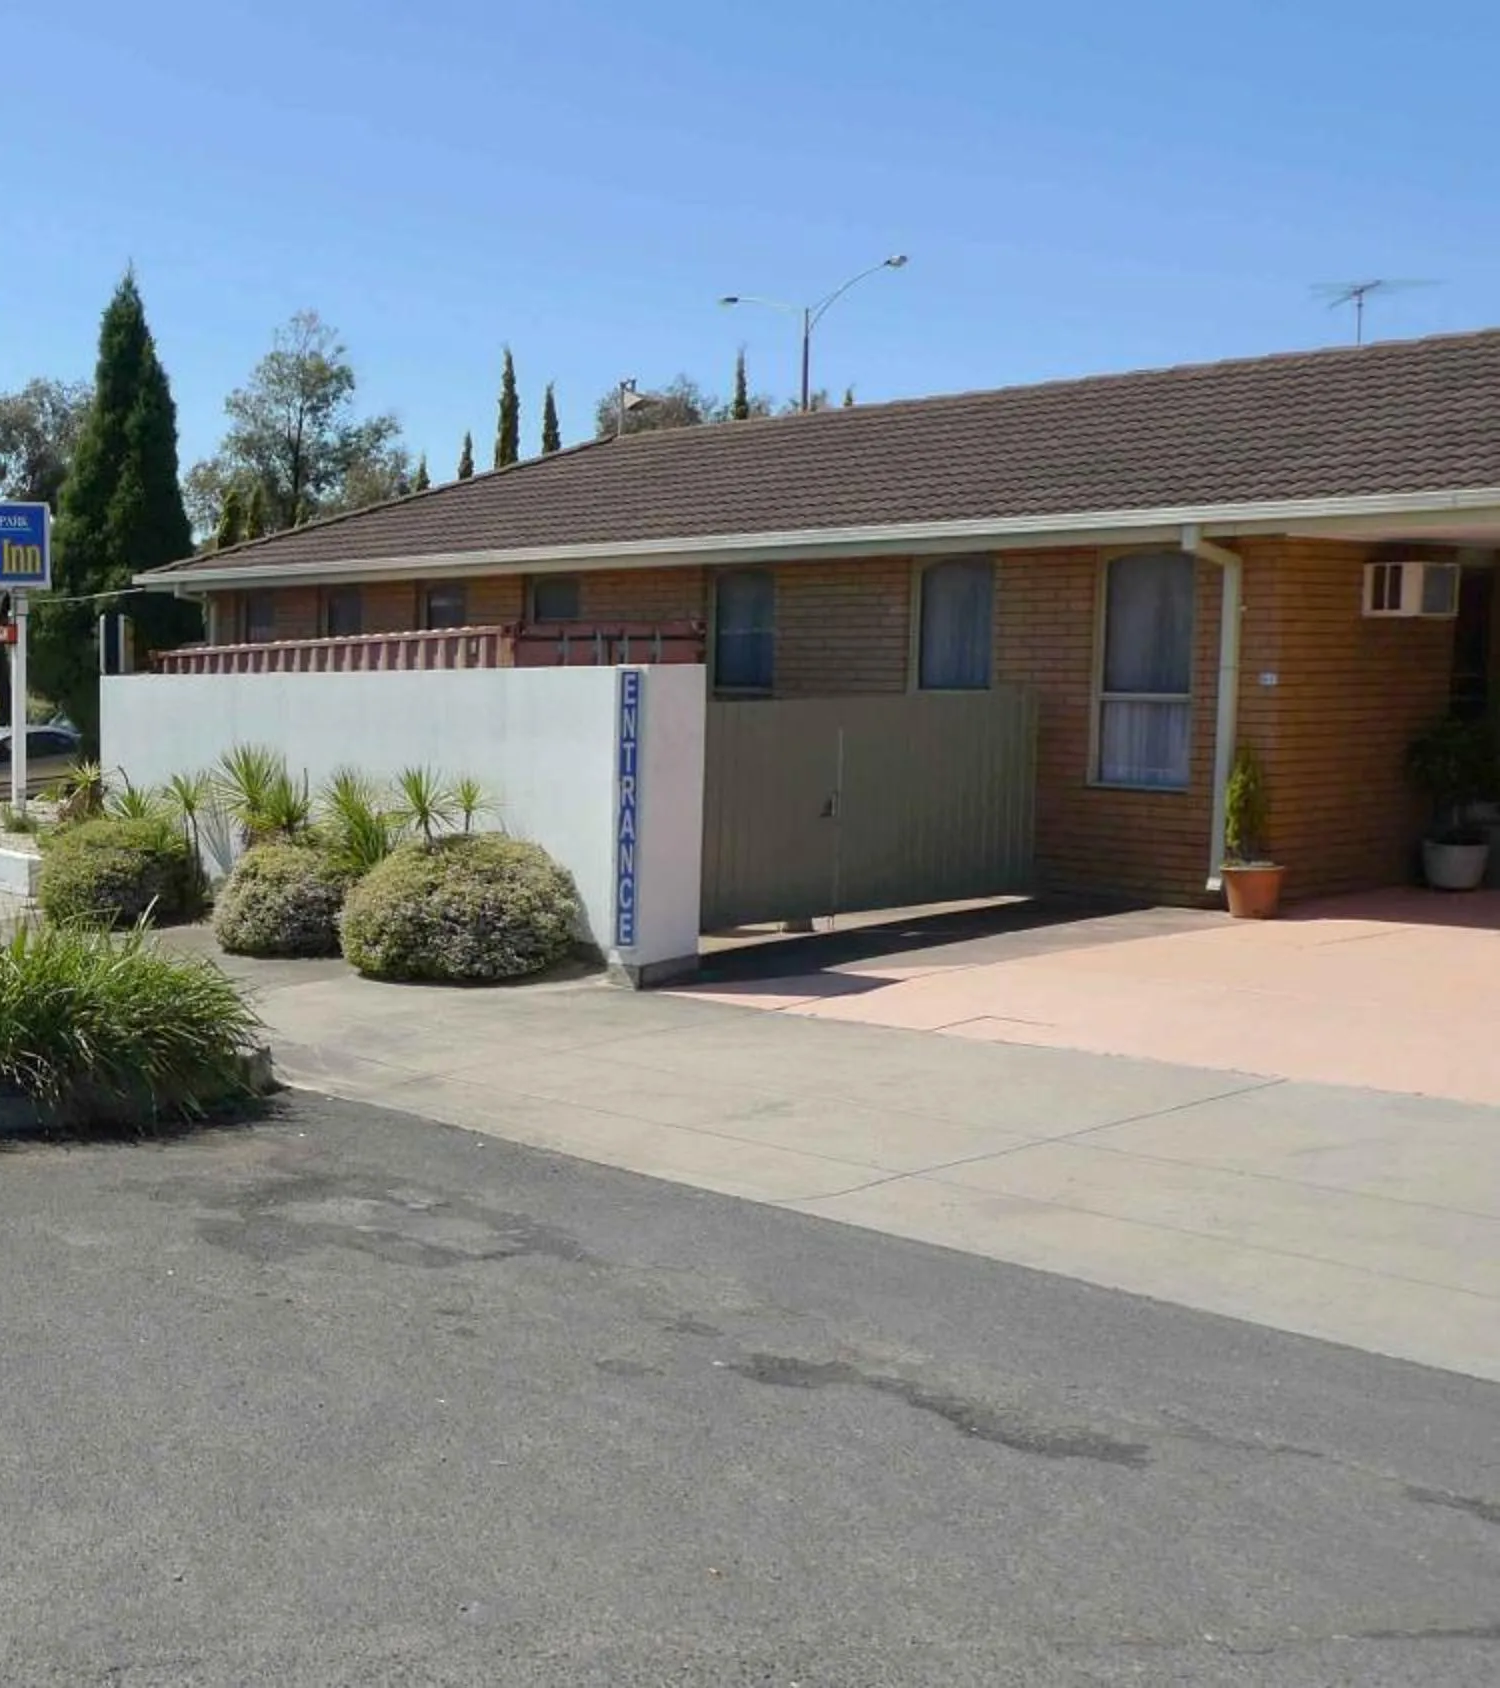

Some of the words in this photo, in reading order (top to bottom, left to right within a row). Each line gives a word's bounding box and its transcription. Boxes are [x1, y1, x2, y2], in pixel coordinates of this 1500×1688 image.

[0, 514, 29, 527] PARK
[2, 538, 41, 575] Inn
[619, 673, 637, 943] ENTRANCE
